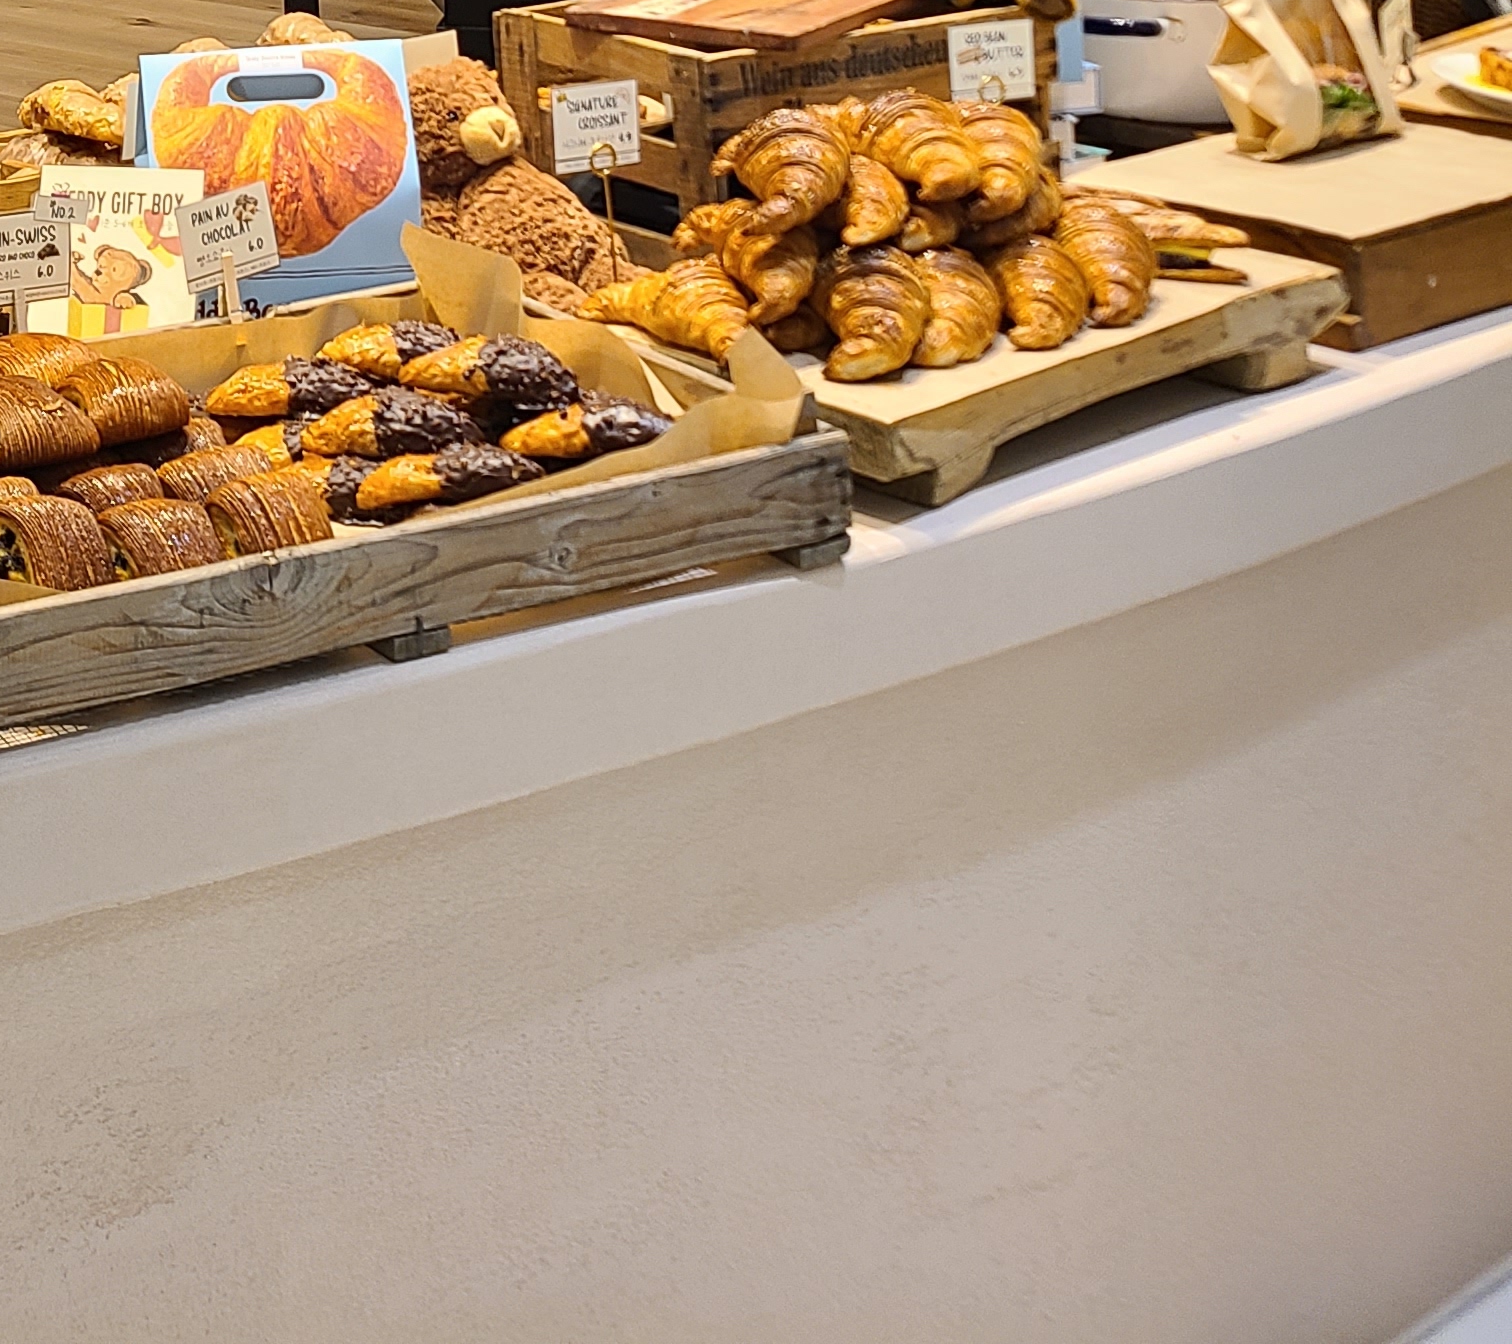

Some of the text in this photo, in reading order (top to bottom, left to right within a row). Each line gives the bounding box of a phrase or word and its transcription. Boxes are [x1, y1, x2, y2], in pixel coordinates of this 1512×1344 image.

[566, 95, 618, 114] SIGNATURE
[577, 111, 628, 130] CROISSANT
[111, 191, 147, 215] GIFT
[151, 193, 185, 216] BOX
[191, 210, 214, 228] PAIN
[215, 202, 230, 220] AU
[201, 220, 251, 246] CHOCOLAT
[248, 237, 264, 252] 6.0
[37, 264, 54, 278] 6.0
